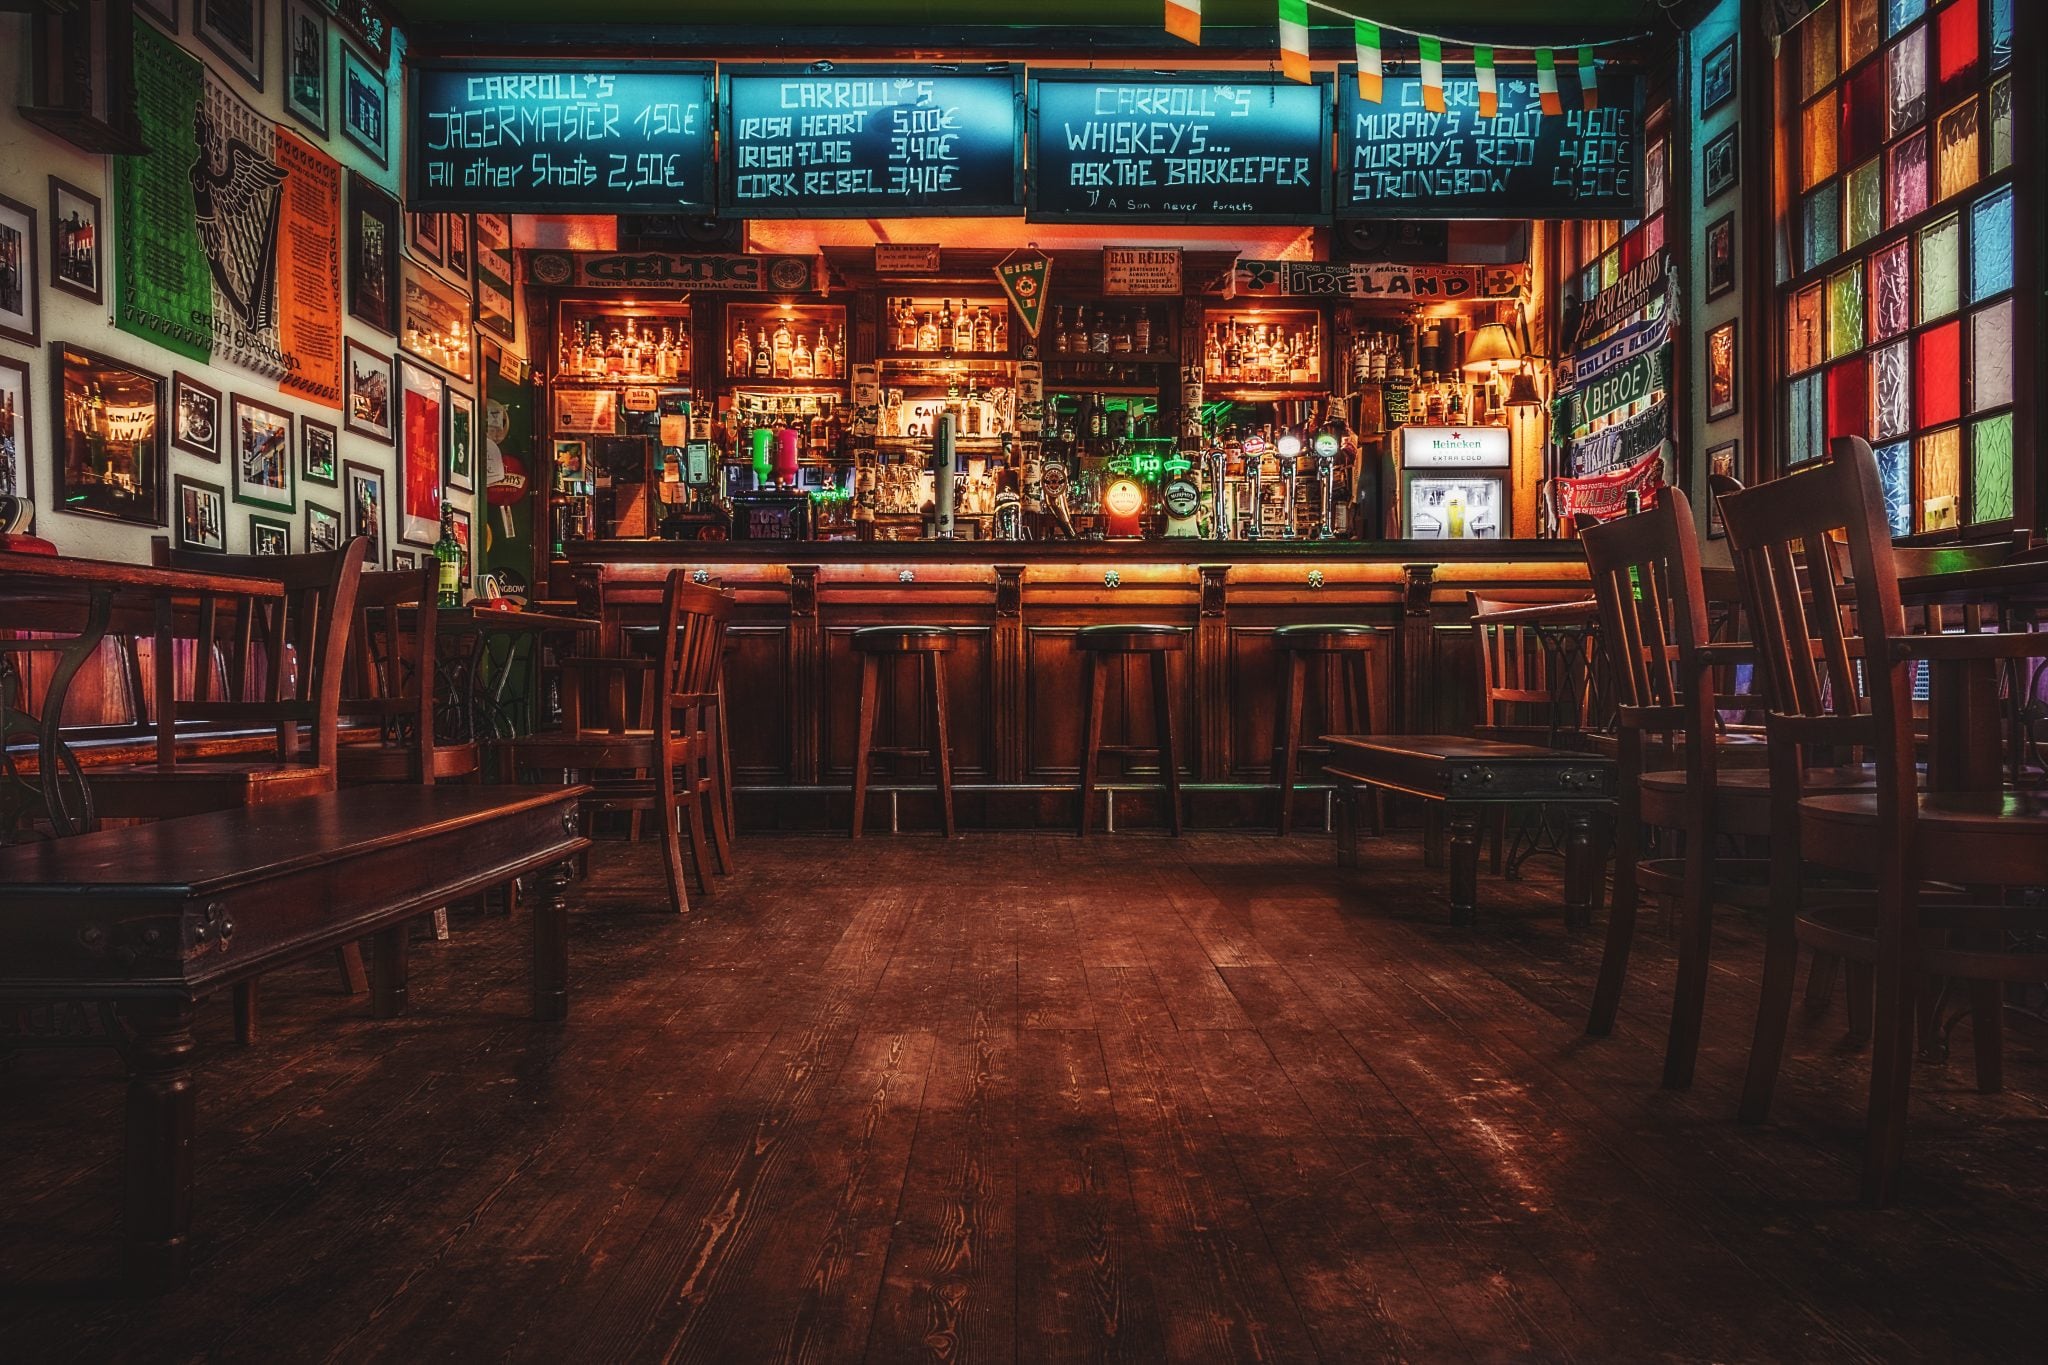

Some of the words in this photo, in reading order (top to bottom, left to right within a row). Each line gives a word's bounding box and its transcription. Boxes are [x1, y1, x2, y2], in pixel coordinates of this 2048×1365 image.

[634, 104, 698, 141] 1,50€
[739, 117, 792, 139] IRISH
[801, 111, 867, 136] HEART
[893, 107, 962, 136] 5,00€
[1356, 112, 1460, 140] MURPHY'S
[739, 146, 793, 168] IRISH
[796, 141, 851, 166] FLAG
[889, 134, 960, 164] 3,40€
[1355, 139, 1463, 168] MURPHY'S
[1476, 139, 1534, 166] RED
[429, 162, 453, 187] All
[465, 157, 524, 187] other
[532, 152, 597, 187] Shots
[608, 154, 684, 192] 2,50€
[737, 172, 799, 198] CORK
[804, 169, 883, 195] REBEL
[888, 166, 963, 196] 3,40€
[1070, 162, 1113, 186] ASK
[1113, 158, 1156, 186] THE
[1164, 157, 1310, 187] BARKEEPER
[1108, 198, 1117, 208] A
[1128, 199, 1150, 210] Son
[1164, 202, 1198, 211] never
[1212, 200, 1253, 212] forgets
[585, 253, 758, 283] CELTIC
[1004, 262, 1044, 276] EIRE
[1110, 252, 1134, 264] BAR
[1138, 252, 1176, 264] RULES
[1326, 266, 1371, 274] WHISKEY
[1294, 272, 1470, 297] IRELAND
[1596, 283, 1618, 320] NEW
[1617, 251, 1660, 305] ZEALAND
[1578, 342, 1624, 379] GALLOS
[1593, 364, 1641, 415] BEROE
[1433, 440, 1482, 449] Heineken
[1574, 487, 1618, 508] WALES
